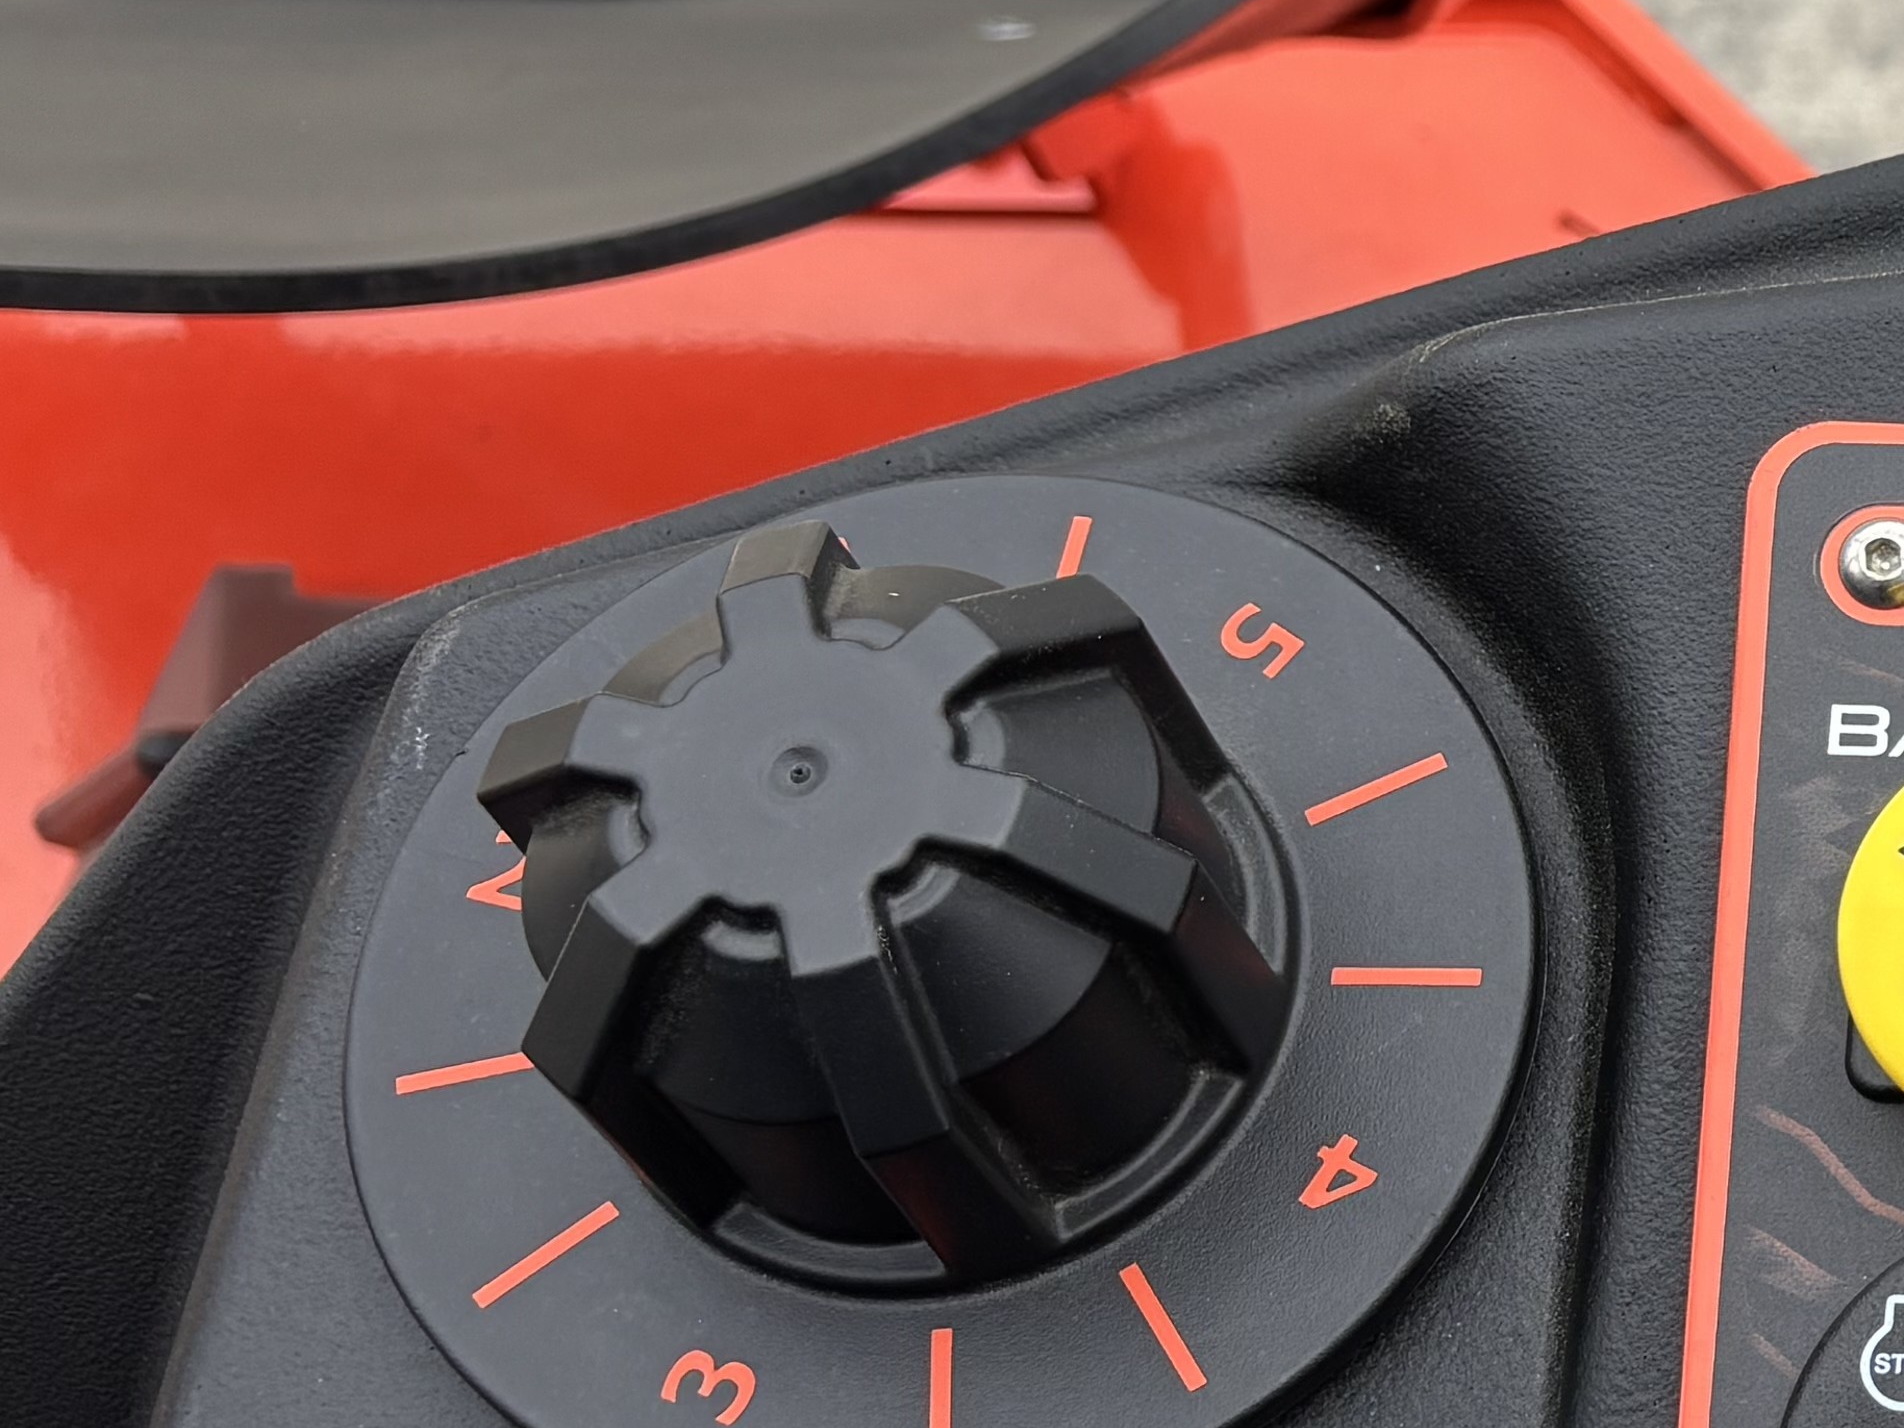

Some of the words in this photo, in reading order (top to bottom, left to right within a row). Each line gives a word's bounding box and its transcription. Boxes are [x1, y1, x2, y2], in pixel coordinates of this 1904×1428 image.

[1219, 602, 1306, 678] 5
[1297, 1134, 1379, 1209] 4
[660, 1348, 757, 1425] 3
